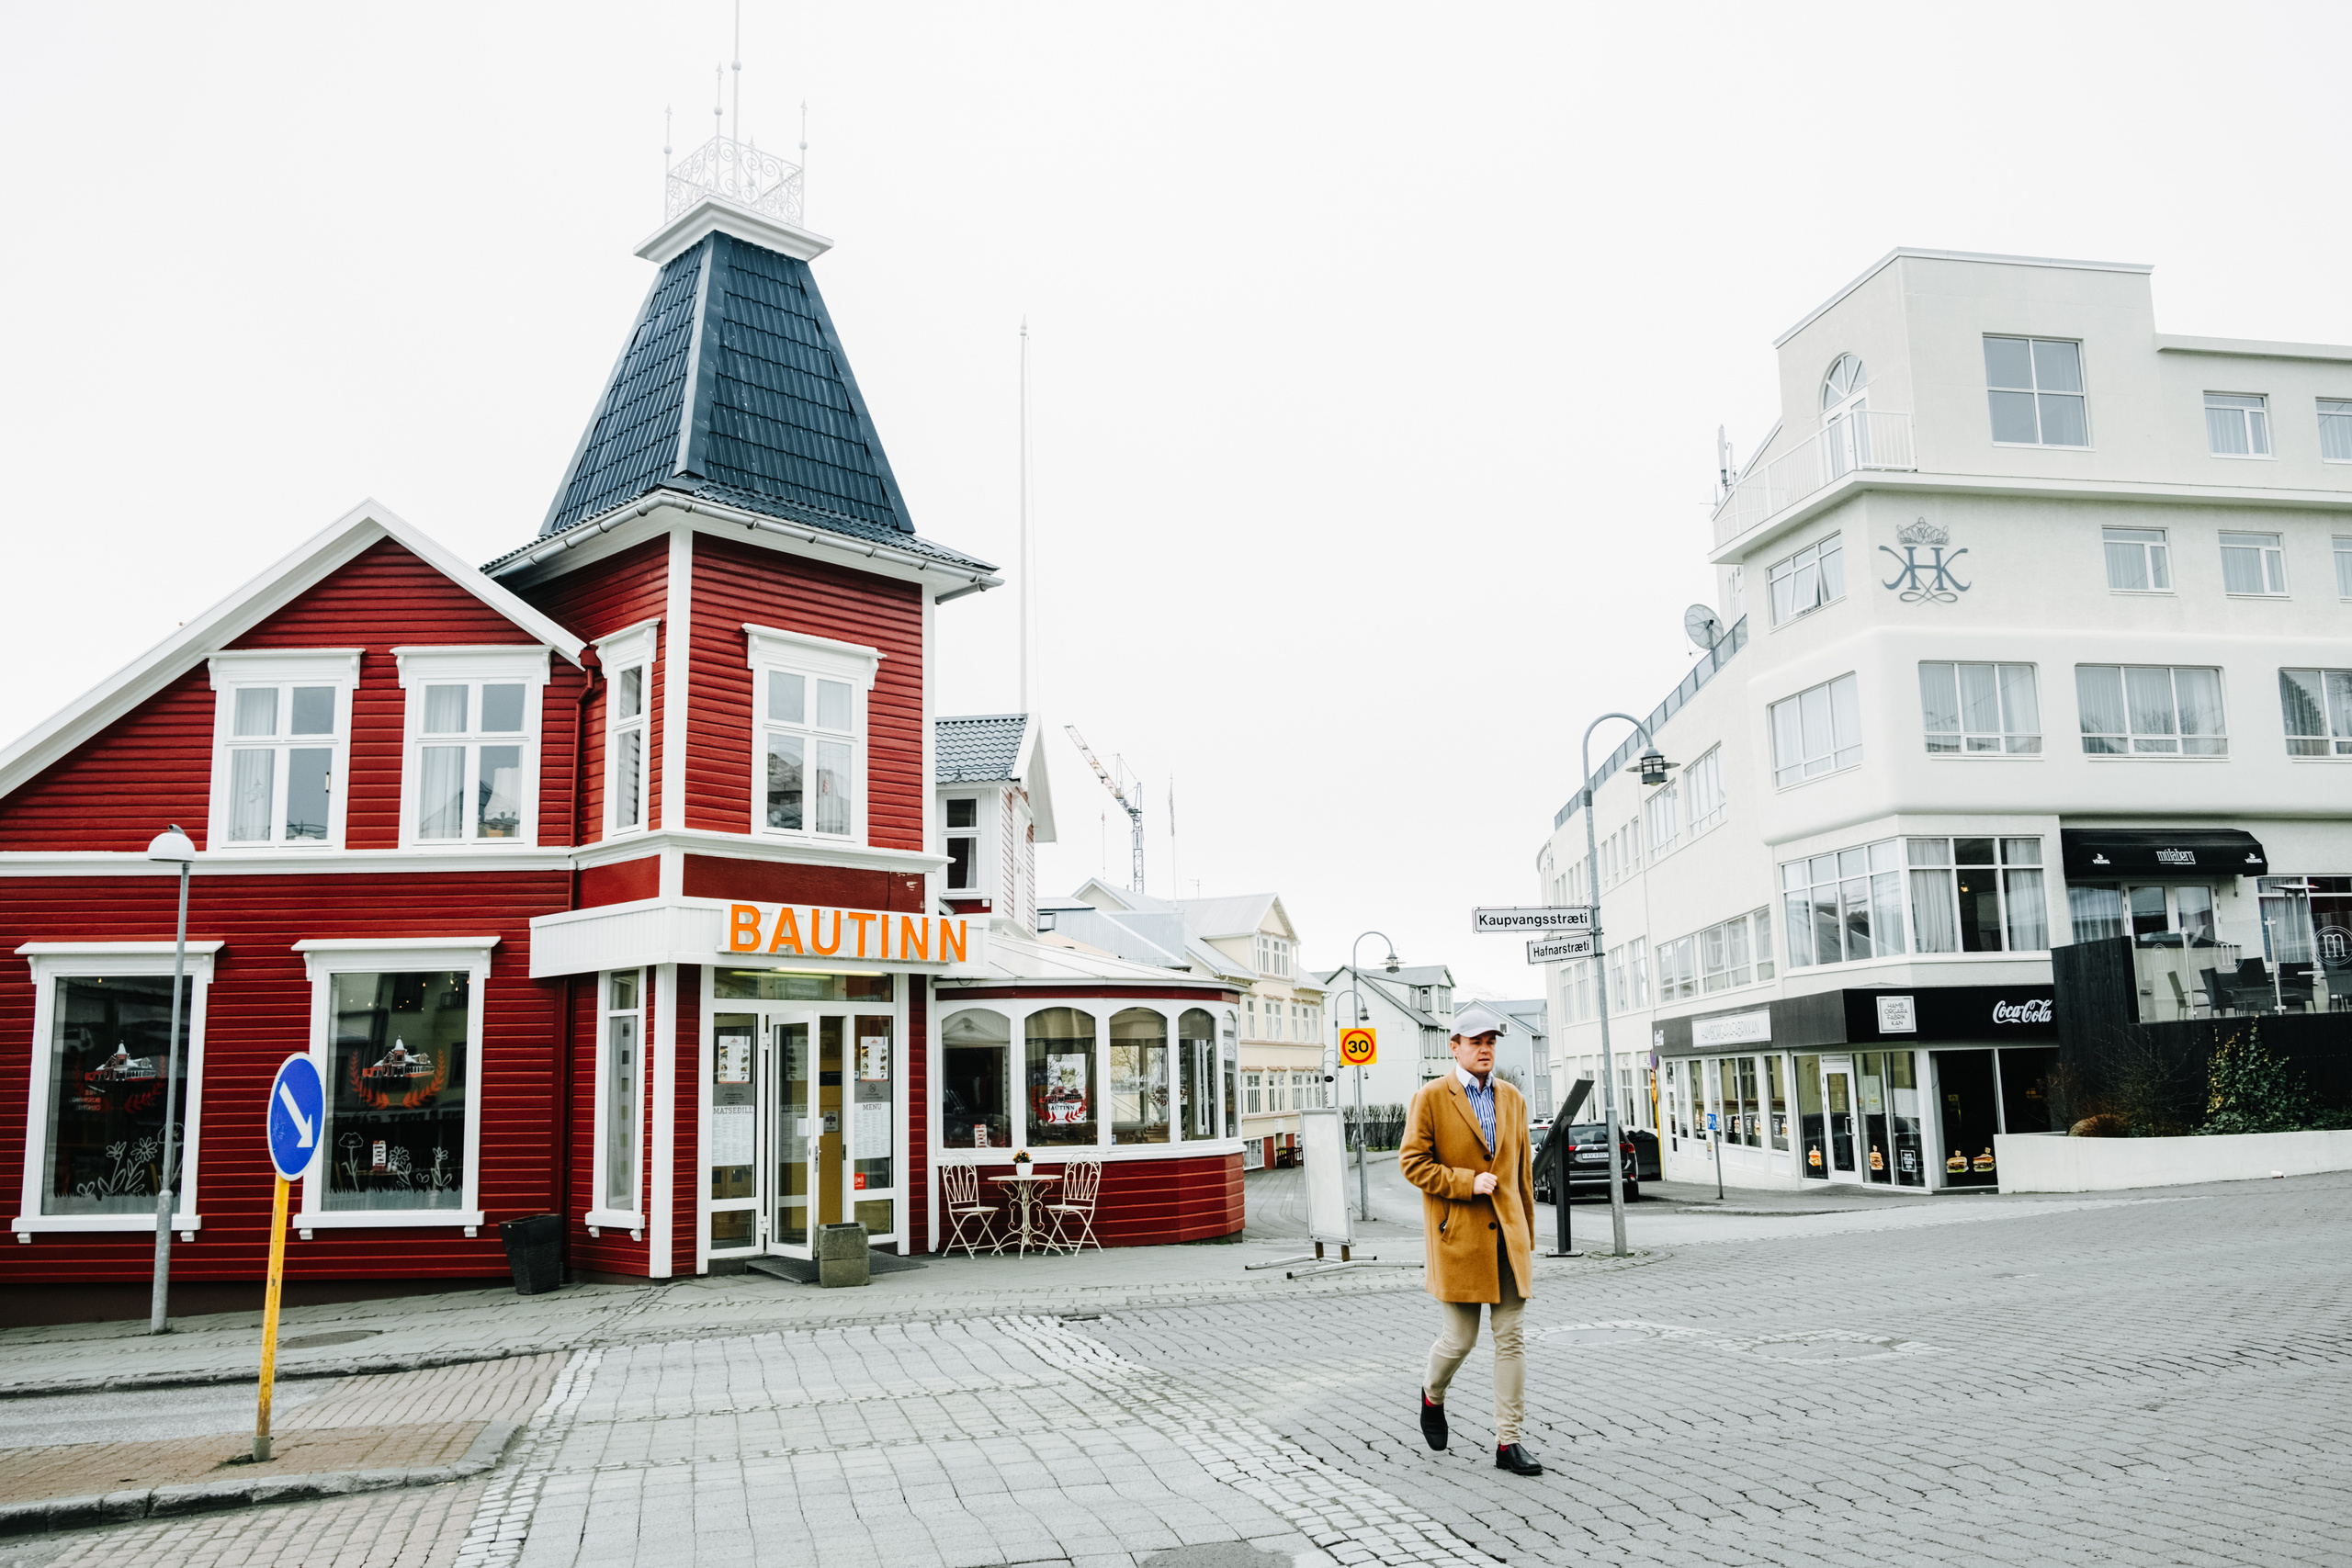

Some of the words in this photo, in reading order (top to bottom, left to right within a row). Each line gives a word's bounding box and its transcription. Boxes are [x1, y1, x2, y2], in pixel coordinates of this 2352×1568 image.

[1478, 912, 1588, 927] Kaupvangsstræti
[729, 904, 967, 962] BAUTINN
[1533, 940, 1589, 957] Hafnarstræti
[1992, 999, 2053, 1023] Coca-Cola
[1348, 1040, 1369, 1053] 30
[713, 1106, 753, 1114] MATSEÐILL
